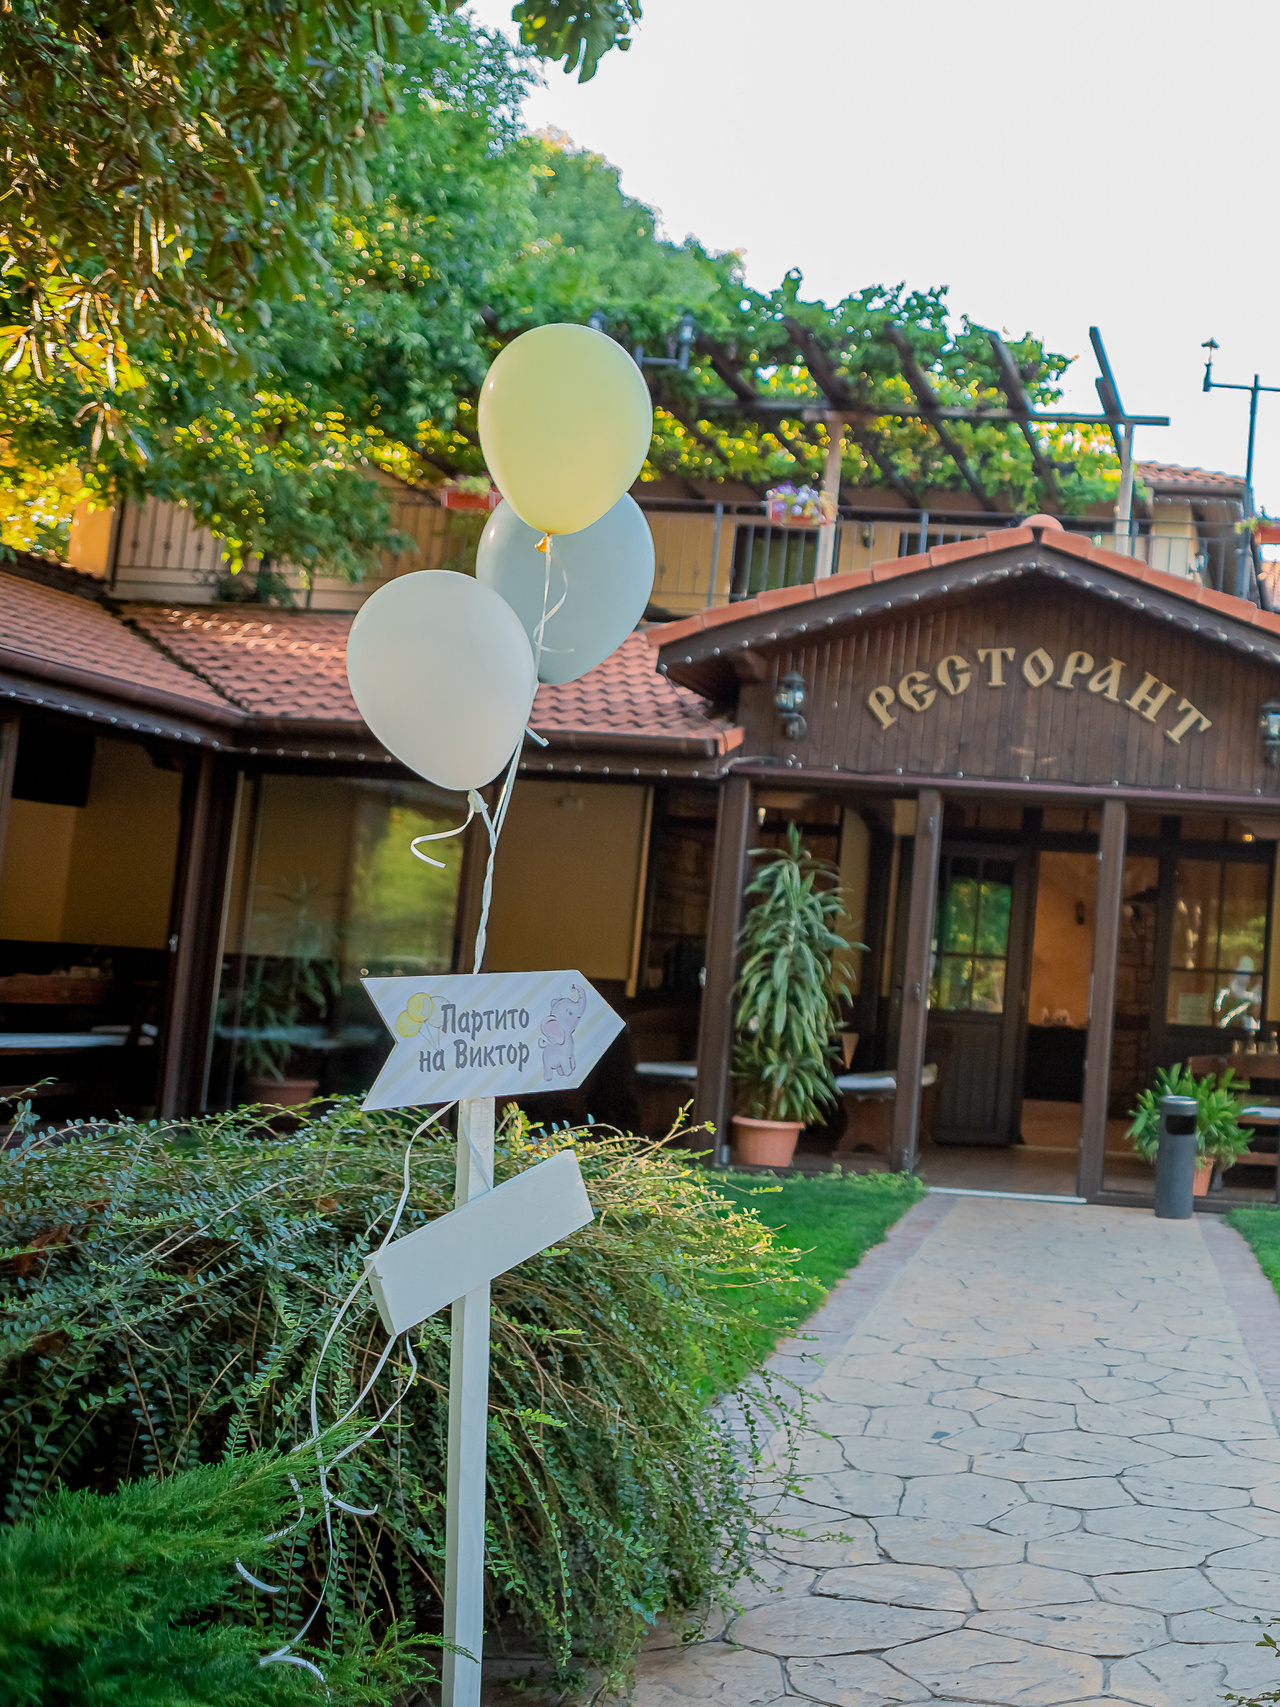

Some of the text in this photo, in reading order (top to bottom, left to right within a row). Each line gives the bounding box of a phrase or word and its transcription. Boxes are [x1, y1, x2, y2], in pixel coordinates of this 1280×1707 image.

[867, 647, 1213, 745] РЕСТОРАНТ
[441, 1003, 530, 1041] Партито
[418, 1040, 530, 1073] на Виктор
